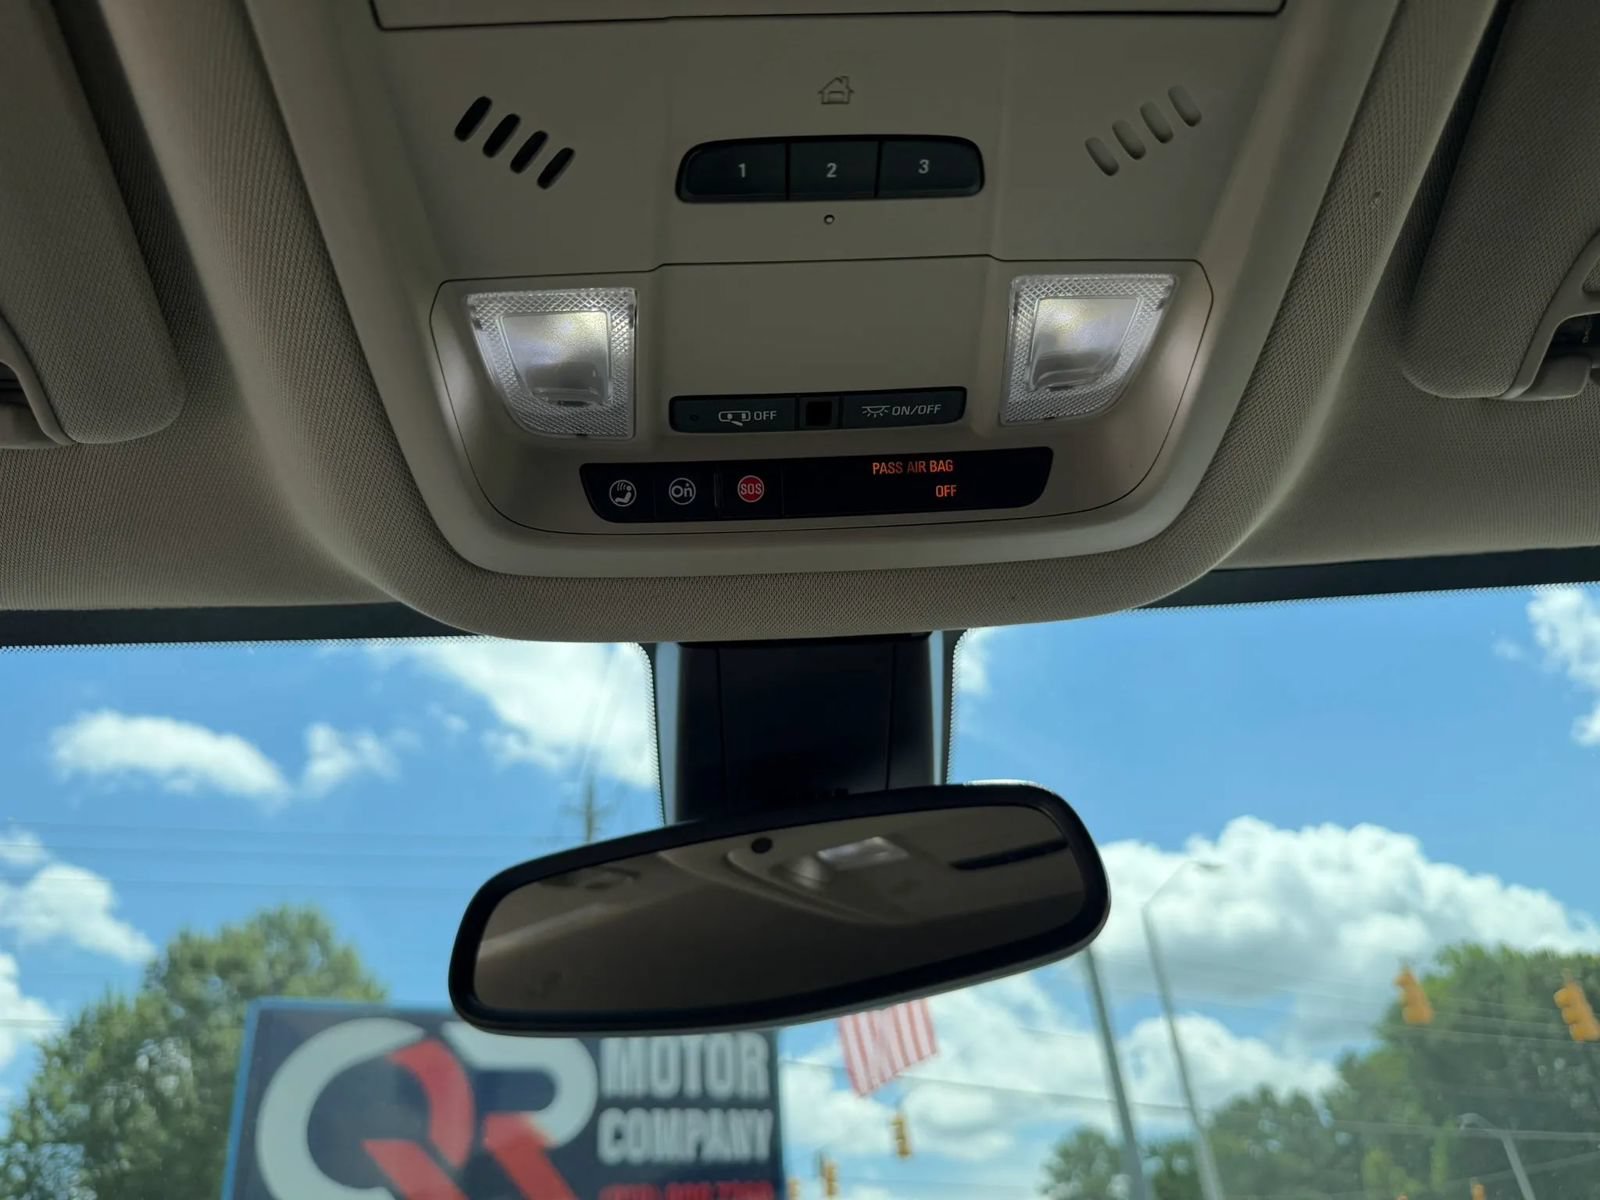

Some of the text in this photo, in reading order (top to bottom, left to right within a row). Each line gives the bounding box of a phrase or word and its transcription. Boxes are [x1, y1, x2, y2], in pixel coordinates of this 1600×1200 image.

[738, 163, 747, 178] 1
[826, 163, 837, 178] 2
[918, 159, 930, 174] 3
[753, 410, 777, 421] OFF
[892, 403, 942, 416] ON/OFF
[872, 459, 954, 475] PASS AIR BAG
[740, 483, 762, 495] SOS
[935, 485, 957, 498] OFF
[600, 1033, 770, 1099] MOTOR
[597, 1107, 774, 1166] COMPANY
